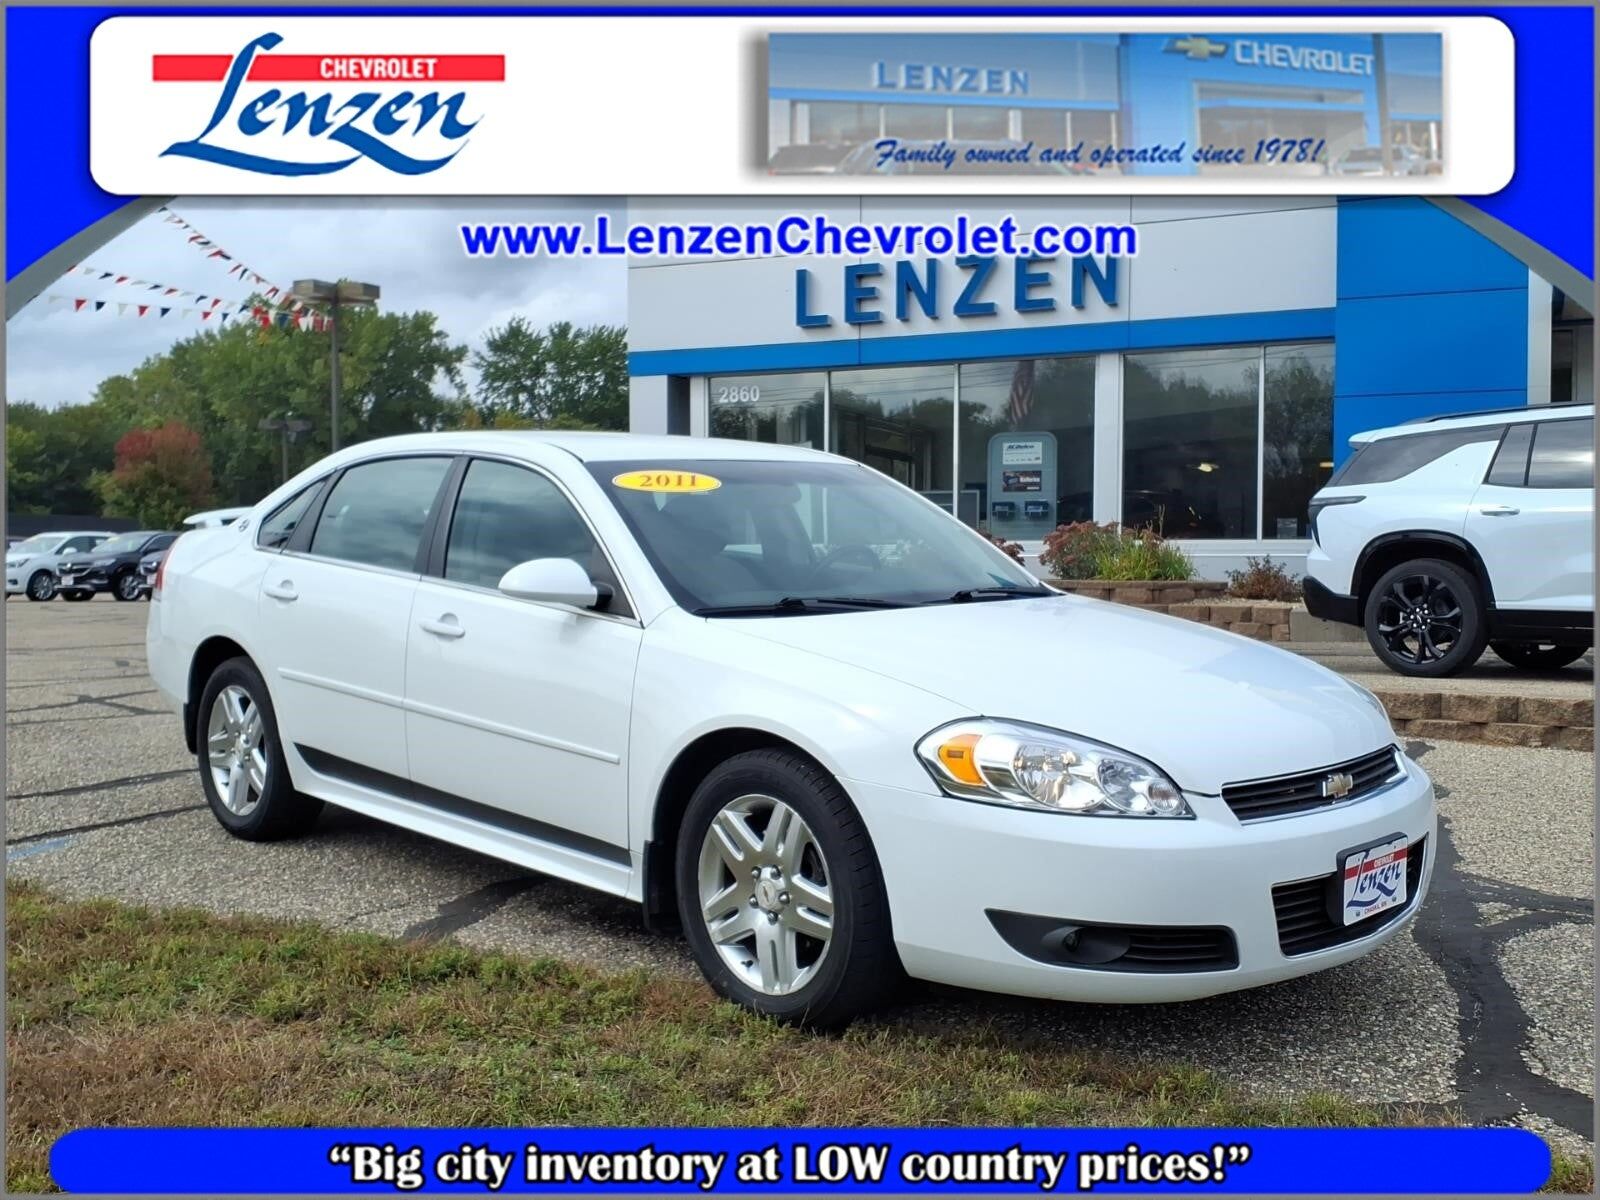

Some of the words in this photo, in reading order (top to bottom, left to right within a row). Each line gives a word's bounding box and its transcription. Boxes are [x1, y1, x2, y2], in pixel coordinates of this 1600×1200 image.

[795, 252, 1119, 328] LENZEN
[719, 385, 760, 403] 2860
[639, 474, 697, 487] 2011
[1346, 849, 1402, 909] Lenzen
